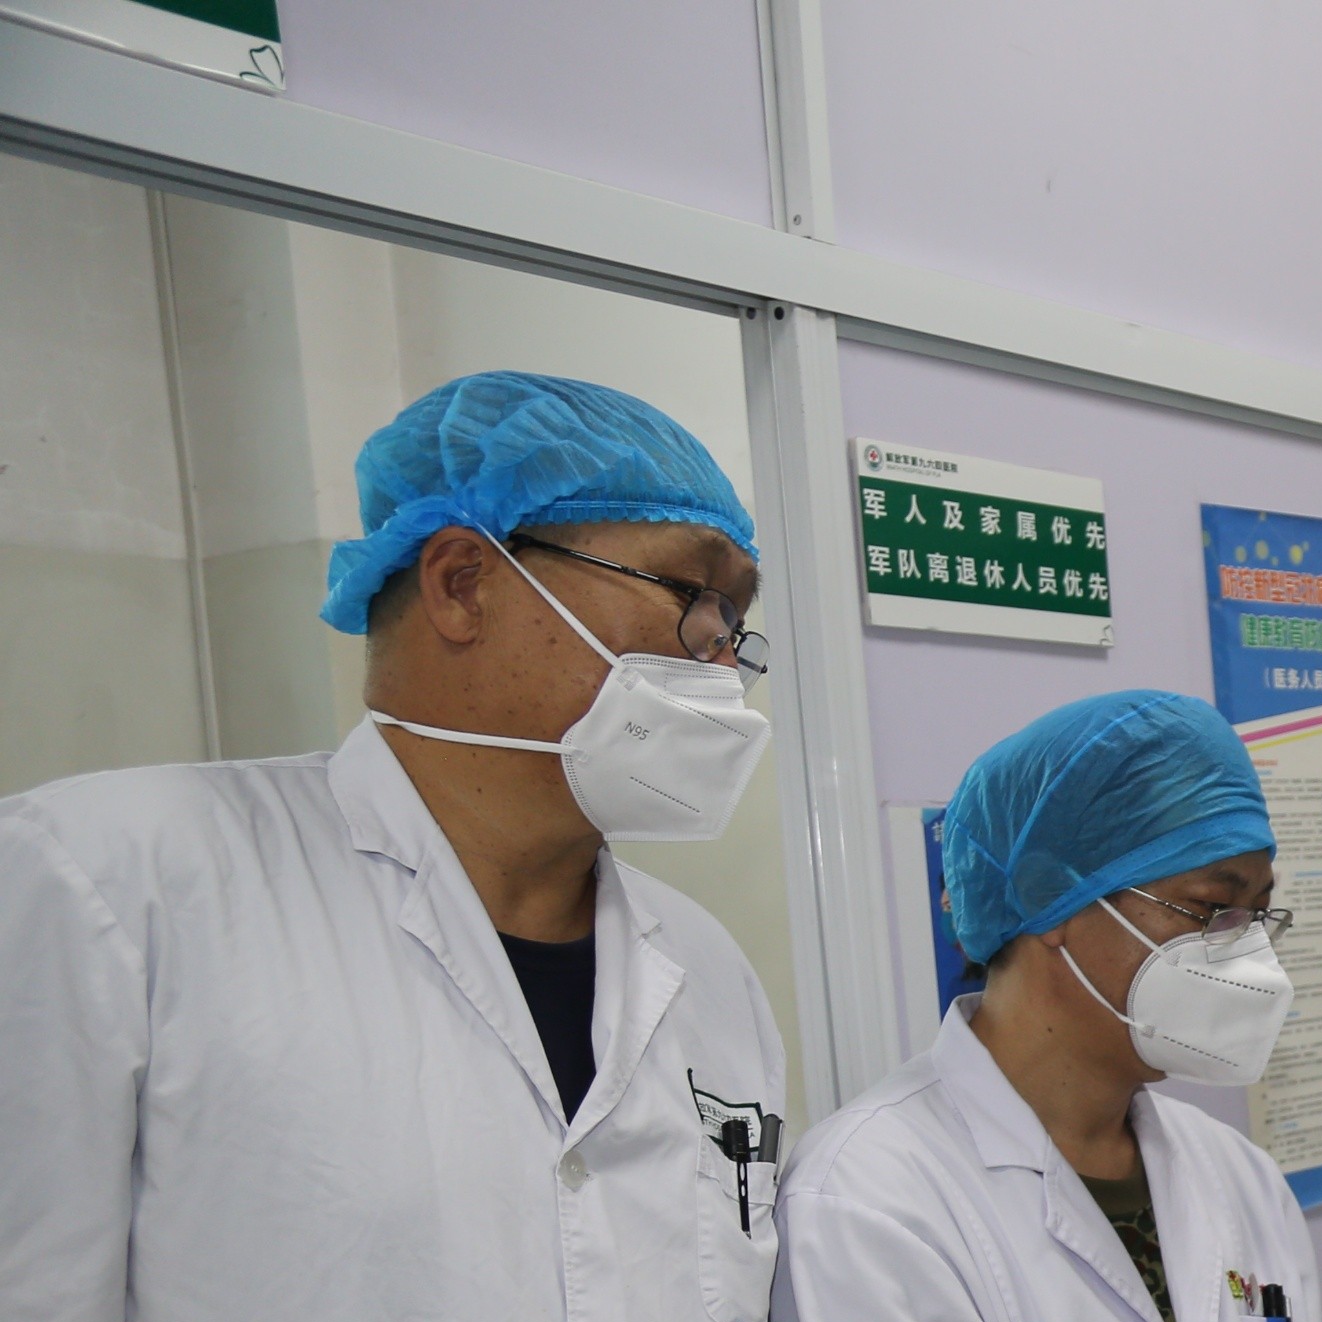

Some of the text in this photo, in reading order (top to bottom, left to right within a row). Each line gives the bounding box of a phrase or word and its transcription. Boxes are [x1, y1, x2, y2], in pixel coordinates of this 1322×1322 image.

[863, 487, 1105, 550] 军人及家属优先
[868, 545, 1109, 601] 军队离退休人员优先
[624, 721, 650, 740] N95
